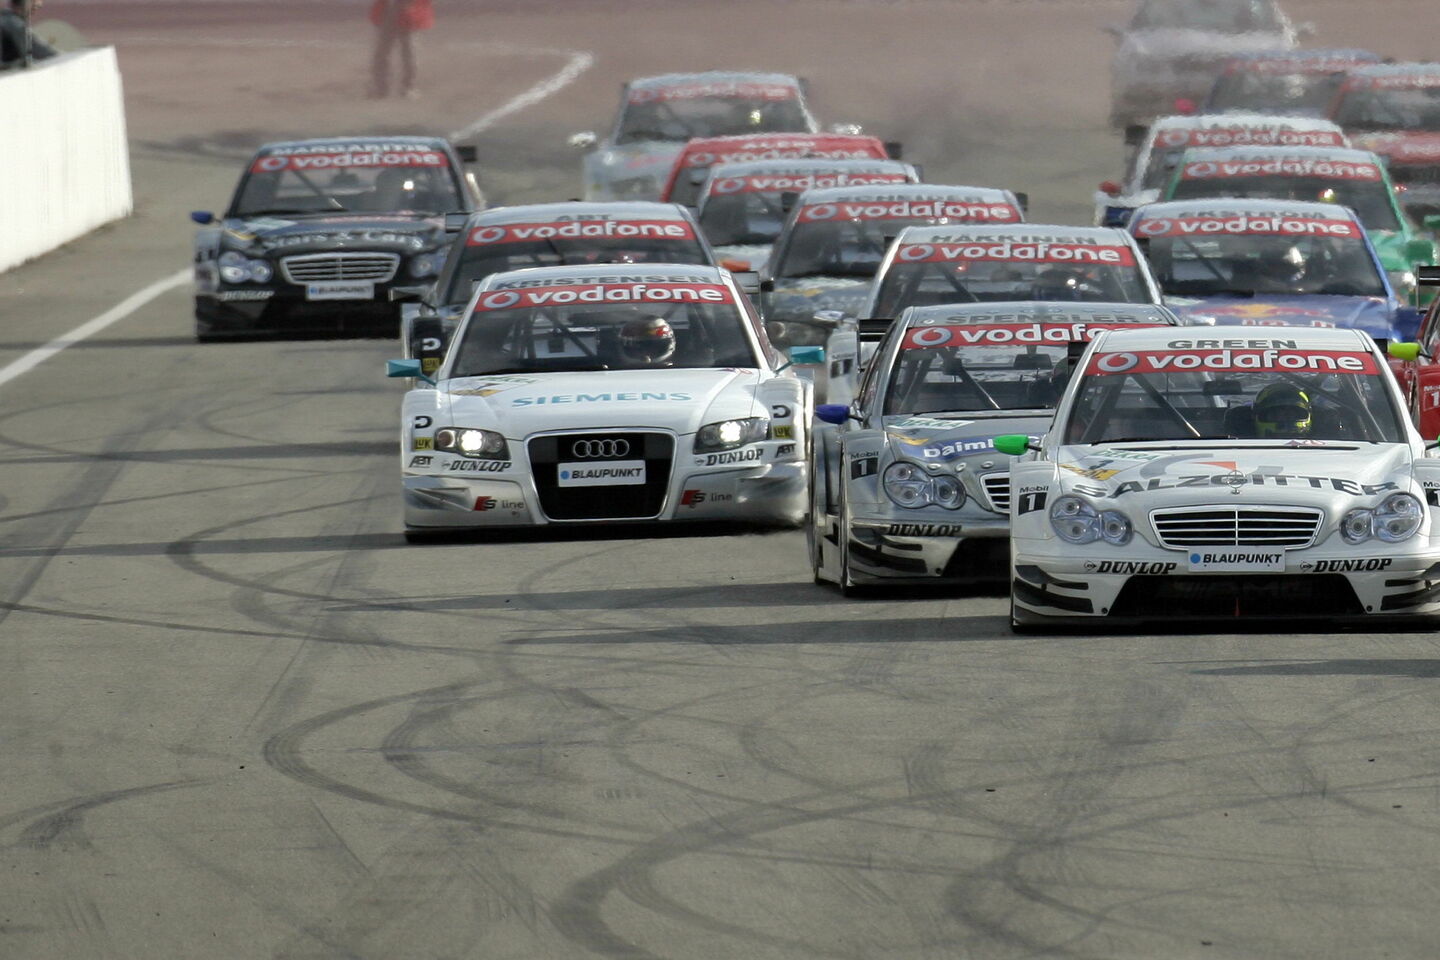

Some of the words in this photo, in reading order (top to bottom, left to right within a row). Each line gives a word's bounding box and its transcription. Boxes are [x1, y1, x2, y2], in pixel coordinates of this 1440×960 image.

[295, 152, 439, 167] vodafone
[1223, 162, 1376, 177] vodafone
[846, 202, 1012, 219] vodafone
[512, 222, 685, 238] vodafone
[1178, 218, 1350, 235] vodafone
[942, 244, 1120, 261] vodafone
[497, 275, 710, 290] KRISTENSEN
[528, 285, 724, 303] vodafone
[947, 314, 1140, 324] SPENGLER
[959, 324, 1108, 343] vodafo
[1167, 340, 1297, 349] GREEN
[1147, 350, 1363, 369] vodafone
[512, 392, 691, 407] SIEMENS
[1431, 391, 1440, 407] 1
[851, 451, 879, 459] Mobil
[923, 438, 994, 458] Daiml
[409, 455, 434, 468] ABT
[706, 449, 764, 466] DUNLOP
[450, 461, 512, 472] DUNLOP
[572, 468, 643, 479] BLAUPUNKT
[858, 460, 867, 475] 1
[502, 498, 524, 509] line
[711, 492, 733, 501] line
[1027, 494, 1036, 511] 1
[888, 524, 962, 537] DUNLOP
[1203, 553, 1282, 564] BLAUPUNKT
[1313, 558, 1392, 573] DUNLOP
[1097, 561, 1177, 575] DUNLOP
